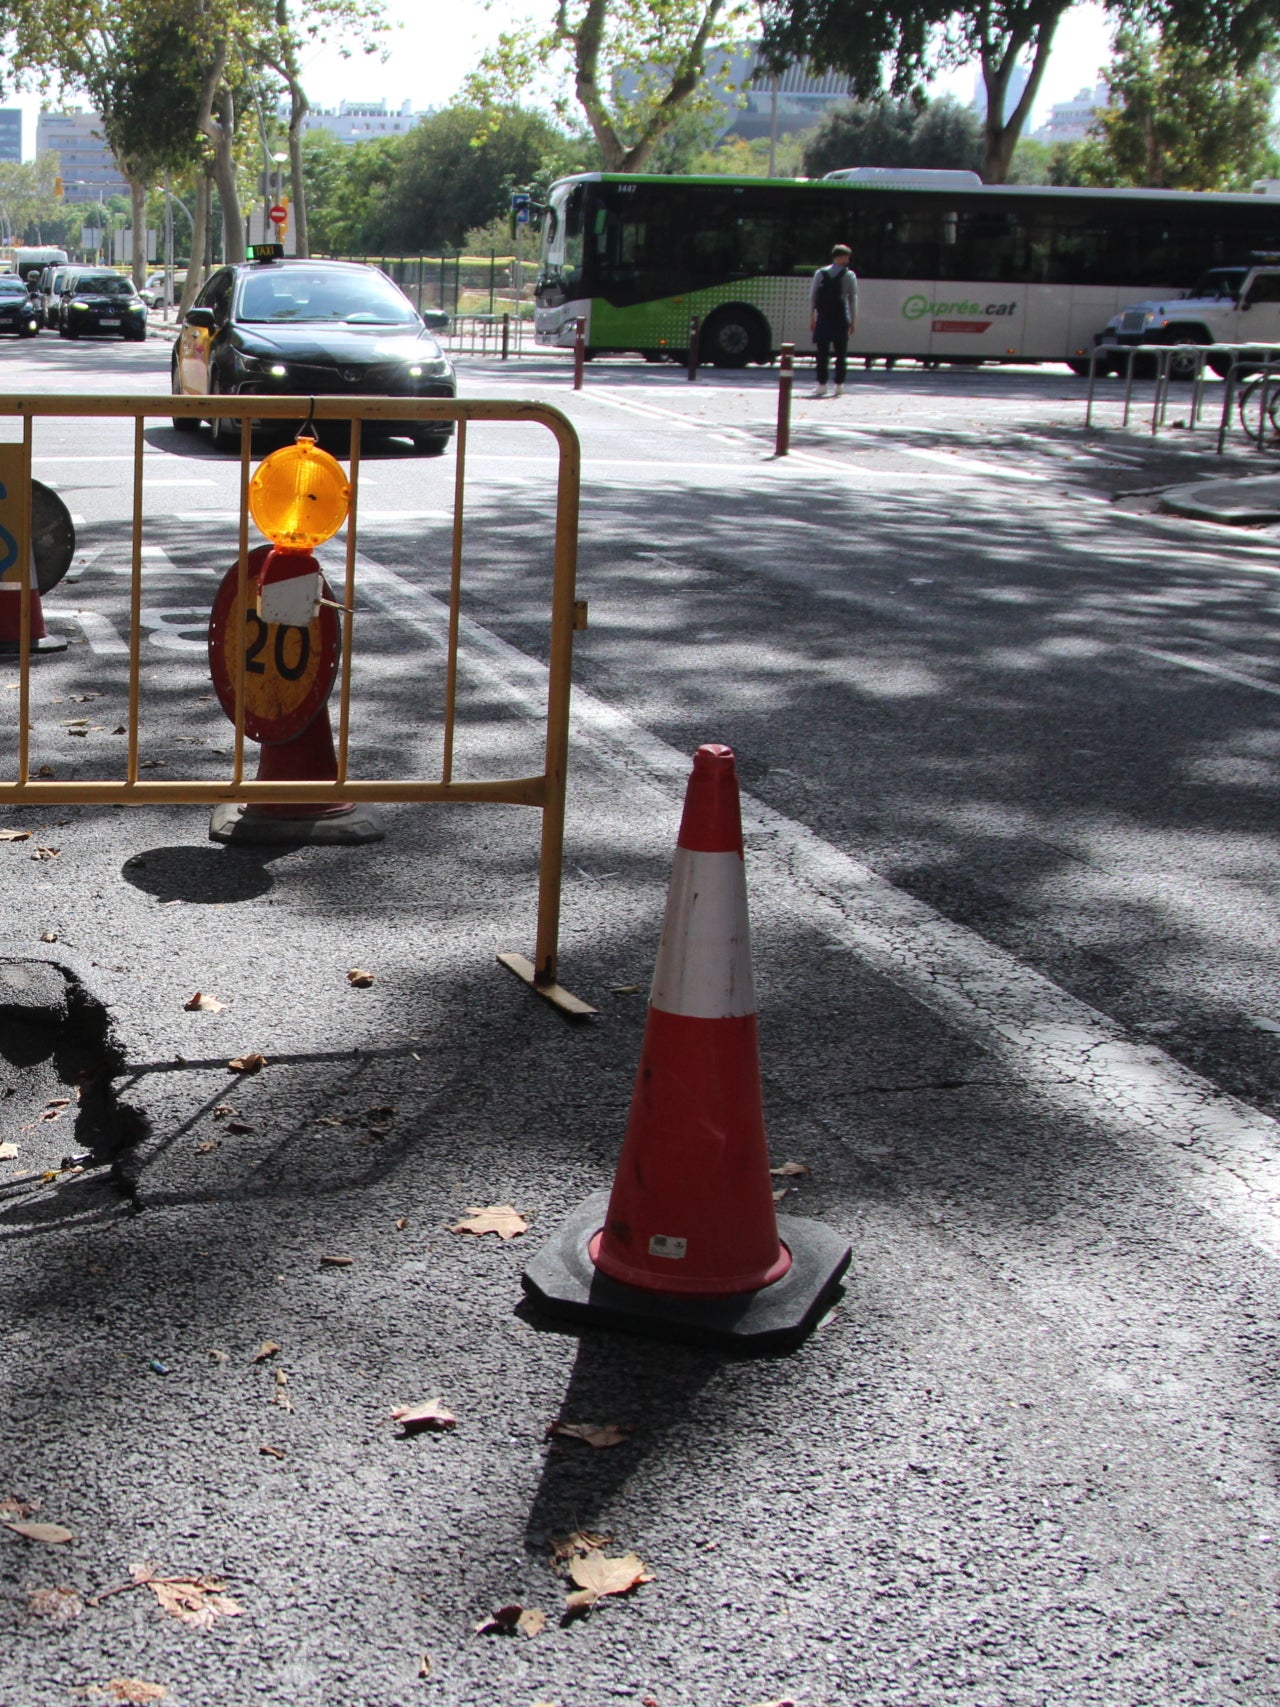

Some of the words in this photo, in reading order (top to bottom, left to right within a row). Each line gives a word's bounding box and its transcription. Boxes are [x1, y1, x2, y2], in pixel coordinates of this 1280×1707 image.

[617, 184, 638, 193] 1447
[256, 245, 274, 257] TAXI
[246, 608, 311, 682] 20
